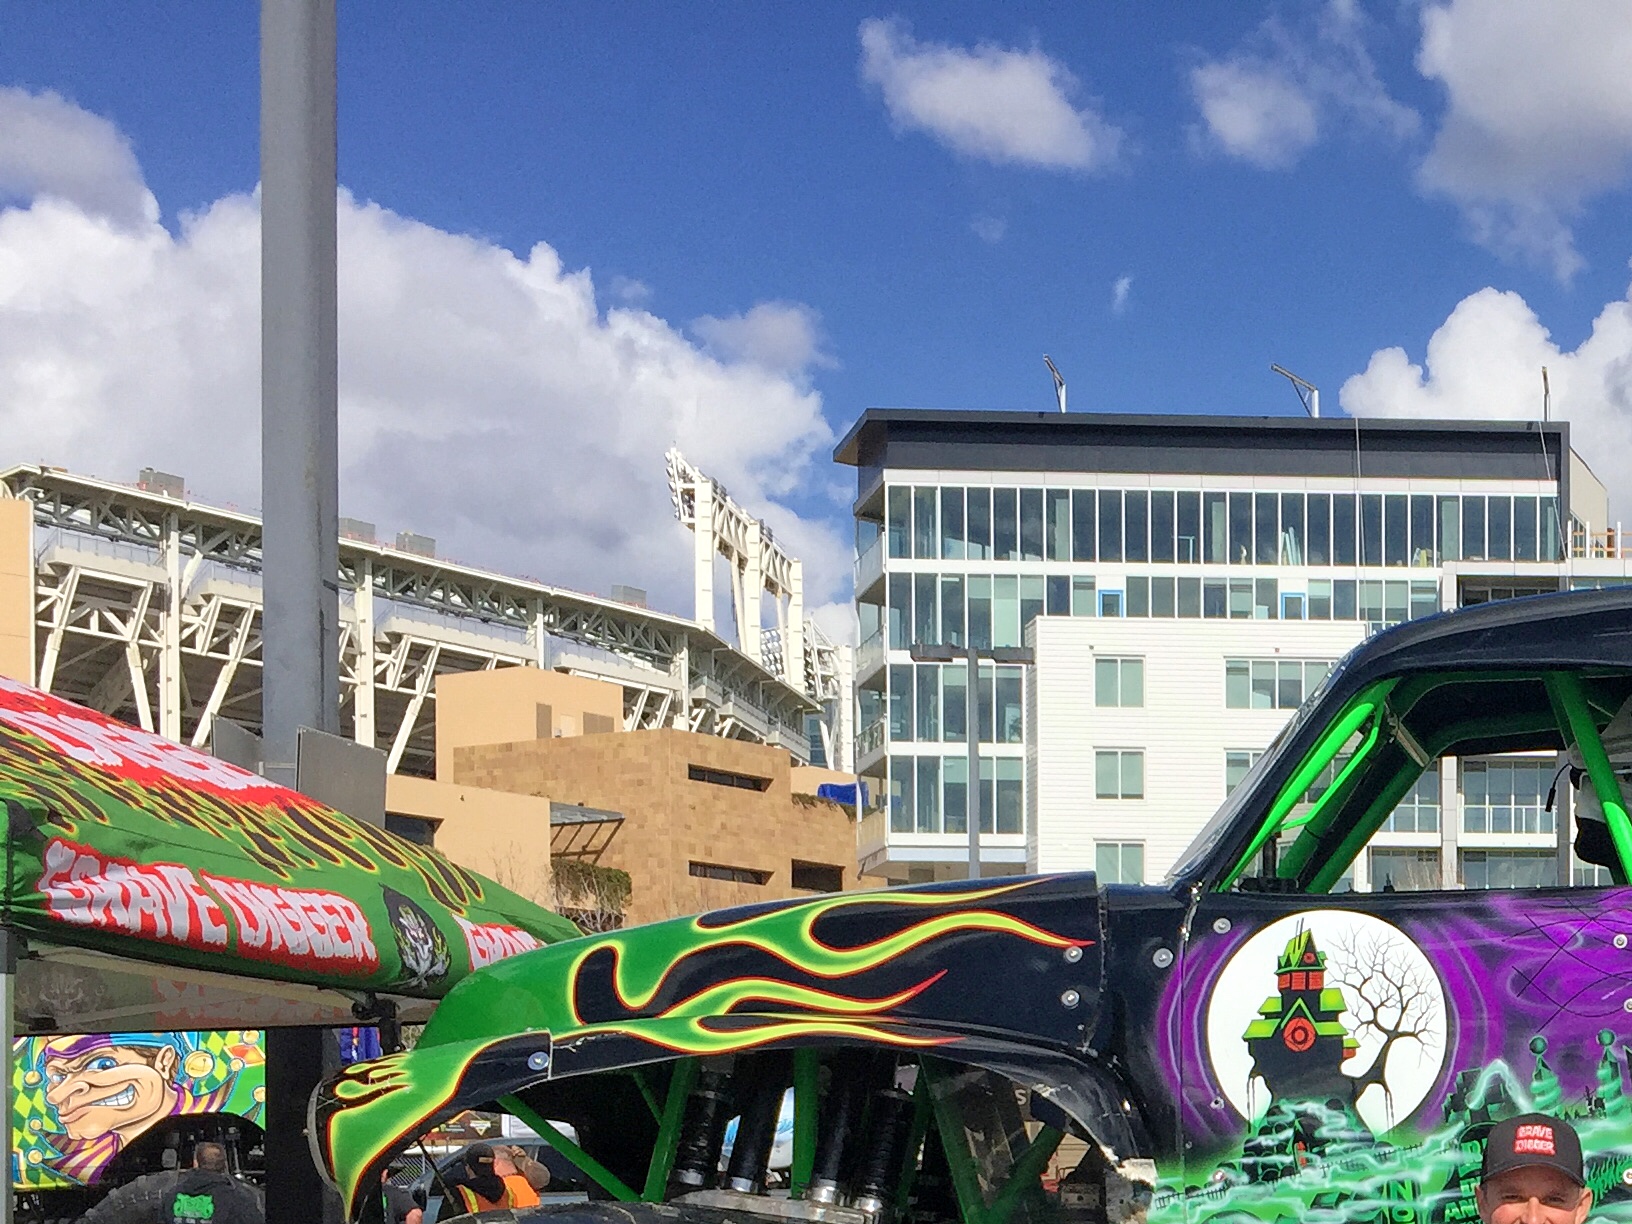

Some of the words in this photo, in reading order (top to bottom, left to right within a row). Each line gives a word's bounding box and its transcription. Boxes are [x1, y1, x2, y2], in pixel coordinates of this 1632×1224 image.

[43, 840, 229, 946] GRAVE
[209, 877, 377, 961] DIGGER
[1517, 1125, 1554, 1139] GRAVE
[1515, 1138, 1555, 1155] DIGGER
